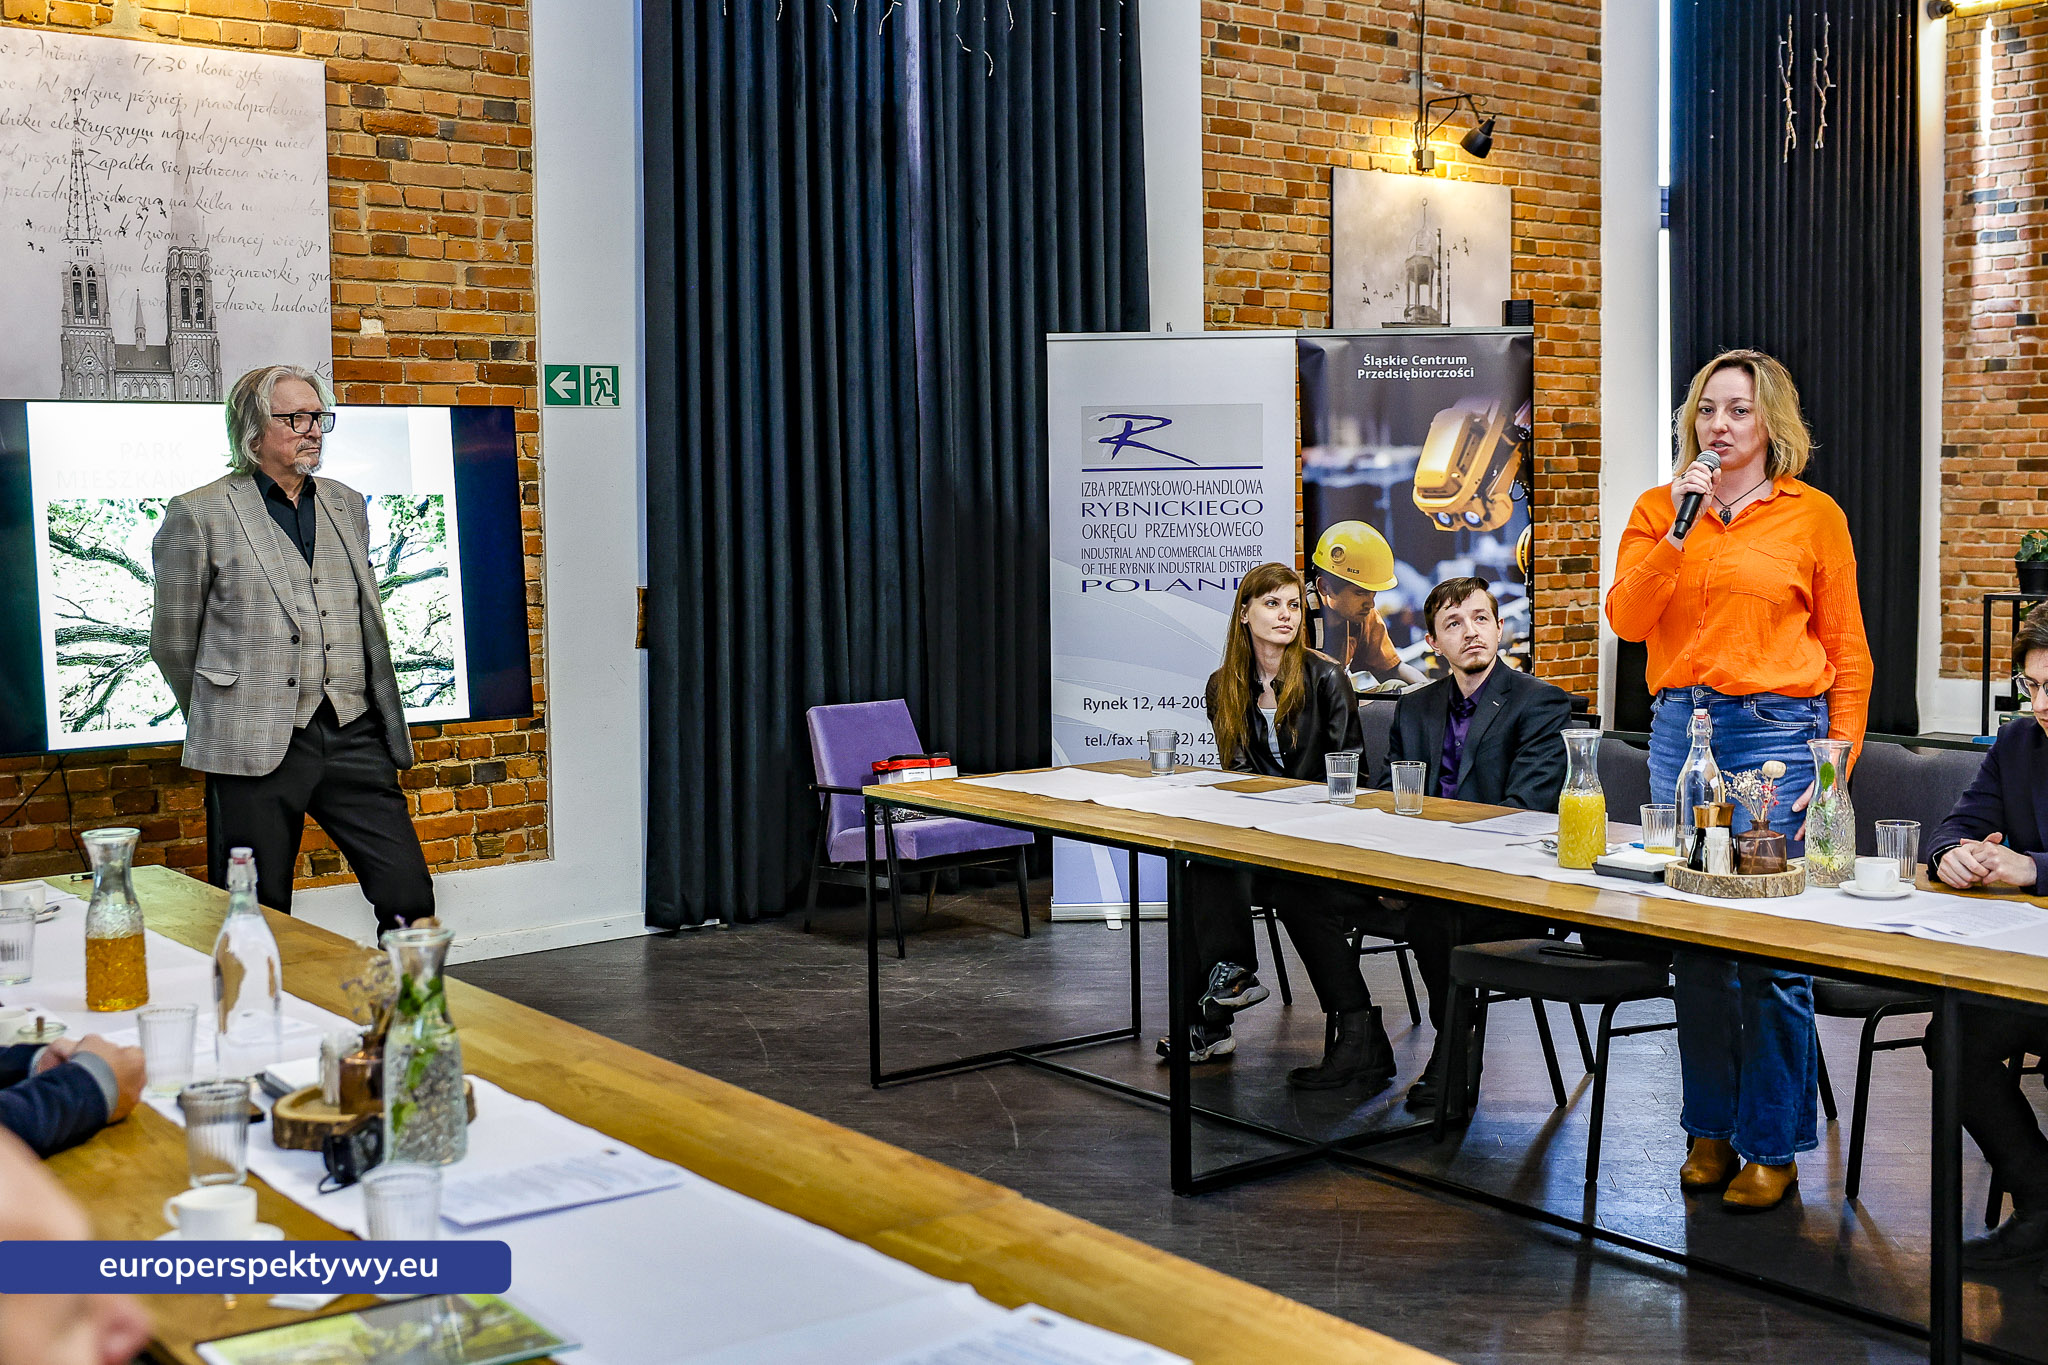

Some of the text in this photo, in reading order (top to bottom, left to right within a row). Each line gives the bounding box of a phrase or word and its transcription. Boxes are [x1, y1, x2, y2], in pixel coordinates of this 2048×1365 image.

[133, 53, 187, 75] 17.30
[36, 73, 59, 93] W
[62, 73, 121, 110] godzinę
[50, 108, 154, 149] elektrycznym
[161, 118, 268, 157] napędzającym
[85, 148, 154, 181] Zapaliła
[161, 160, 181, 176] się
[185, 158, 249, 185] północna
[193, 185, 233, 214] kilka
[135, 214, 179, 250] dzwon
[1363, 353, 1468, 368] Śląskie Centrum
[1357, 367, 1475, 381] Przedsiębiorczości
[119, 440, 184, 461] PARK
[1081, 479, 1263, 497] IZBA PRZEMYSŁOWO-HANDLOWA
[1081, 499, 1264, 518] RYBNICKIEGO
[1081, 521, 1264, 542] OKRĘGU PRZEMYSŁOWEGO
[1081, 545, 1263, 560] INDUSTRIAL AND COMMERCIAL CHAMBER
[1081, 563, 1095, 575] OF
[1098, 562, 1117, 575] THE
[1119, 562, 1156, 574] RYBNIK
[1158, 561, 1216, 574] INDUSTRIAL
[1083, 696, 1128, 713] Rynek
[1132, 696, 1154, 711] 12,
[1085, 733, 1133, 747] tel./fax
[1198, 732, 1215, 745] 42
